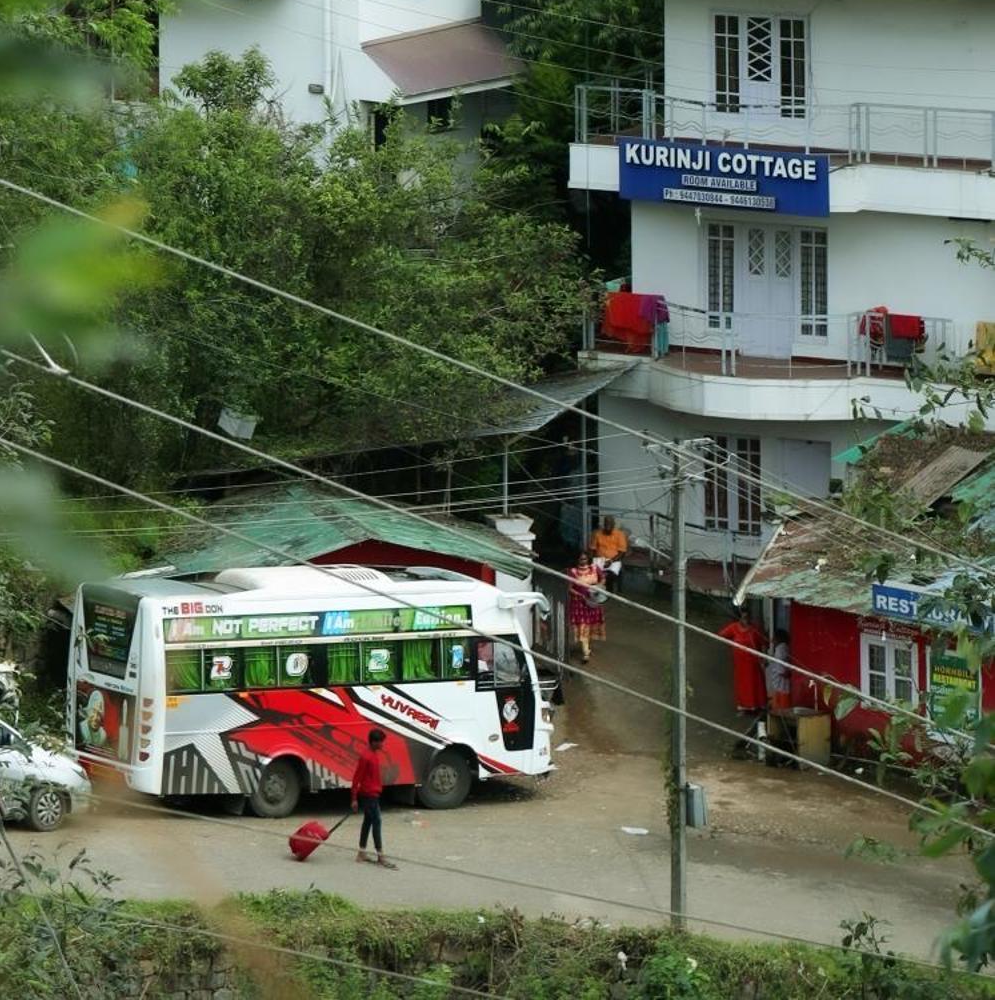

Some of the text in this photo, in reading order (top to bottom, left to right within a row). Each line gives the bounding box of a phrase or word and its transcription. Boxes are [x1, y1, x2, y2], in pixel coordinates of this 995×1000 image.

[625, 143, 817, 180] KURINJI COTTAGE
[710, 178, 756, 191] AVAILABLE
[181, 602, 204, 614] BIG
[212, 618, 244, 635] NOT
[247, 615, 320, 634] PERFECT
[334, 613, 355, 629] Am
